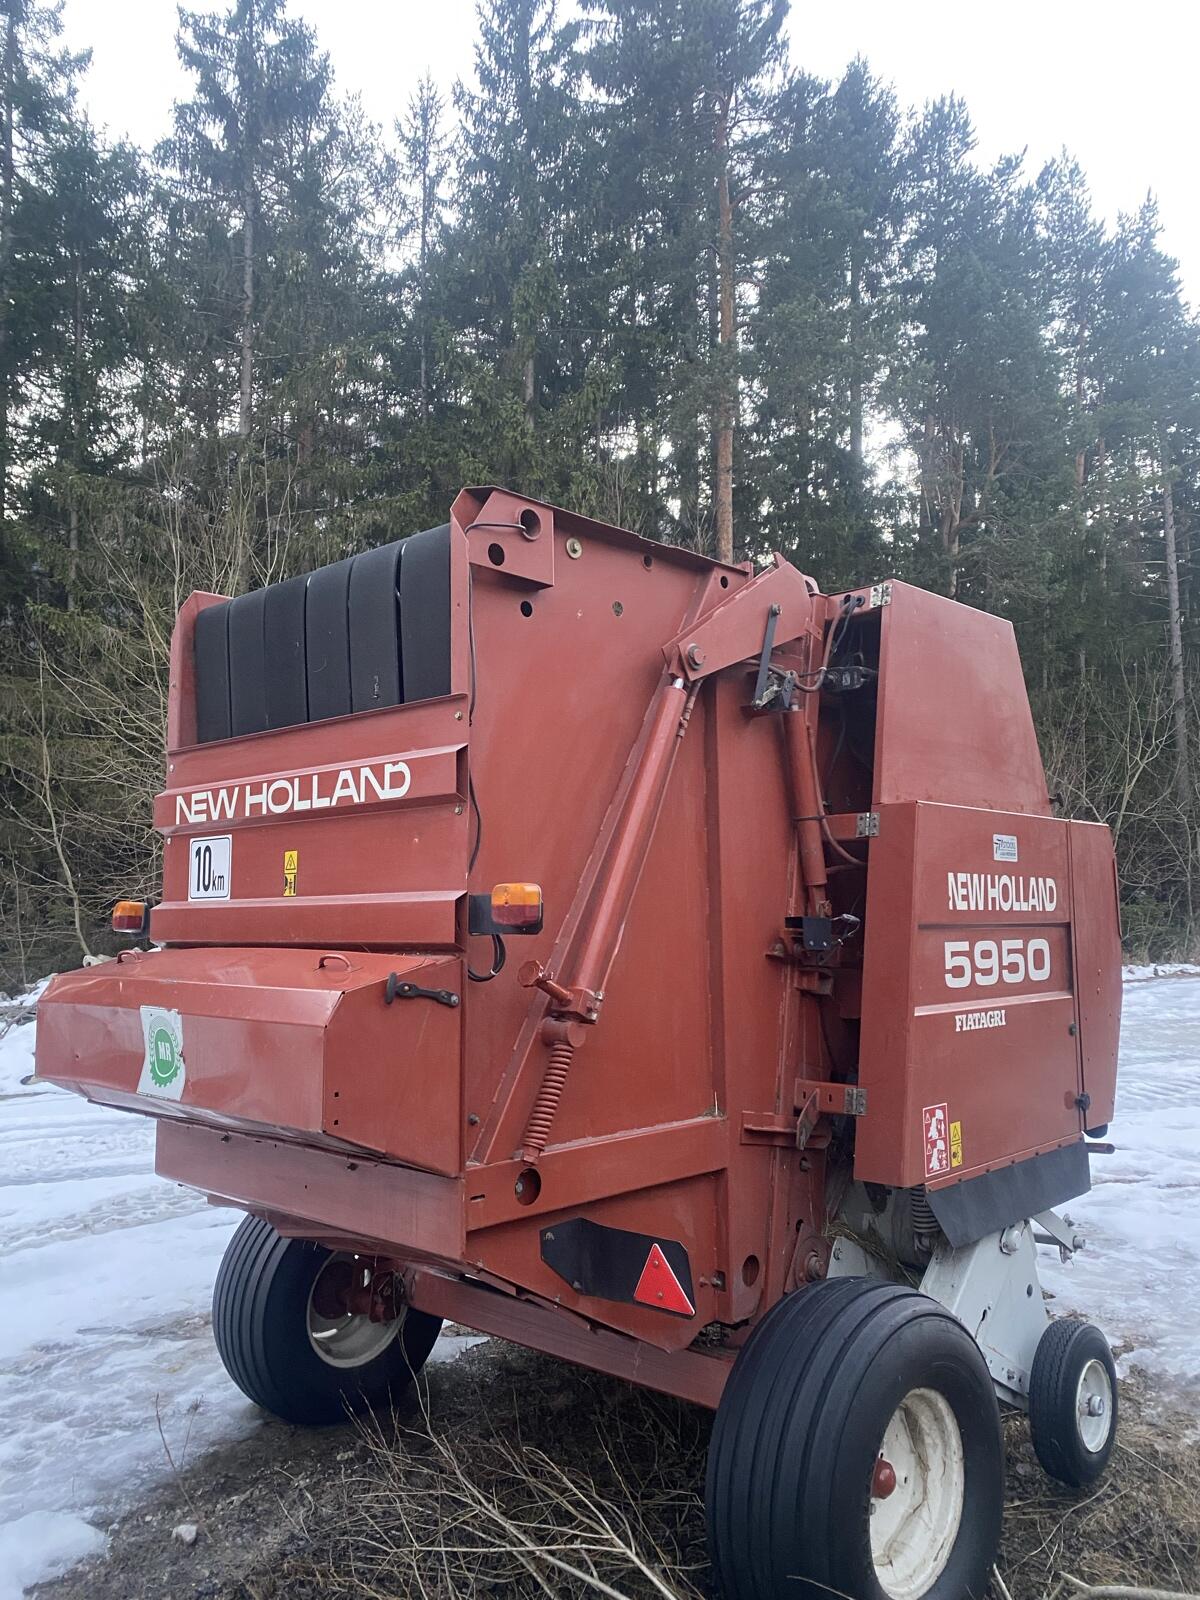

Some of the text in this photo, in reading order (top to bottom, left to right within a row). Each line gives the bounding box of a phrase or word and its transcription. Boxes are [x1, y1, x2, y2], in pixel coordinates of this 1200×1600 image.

[176, 761, 411, 825] NEW HOLLAND
[195, 845, 225, 892] 10 km
[947, 872, 1057, 912] NEW HOLLAND
[944, 938, 1051, 989] 5950
[955, 1009, 1007, 1032] FIATAGRI
[158, 1041, 172, 1061] MR
